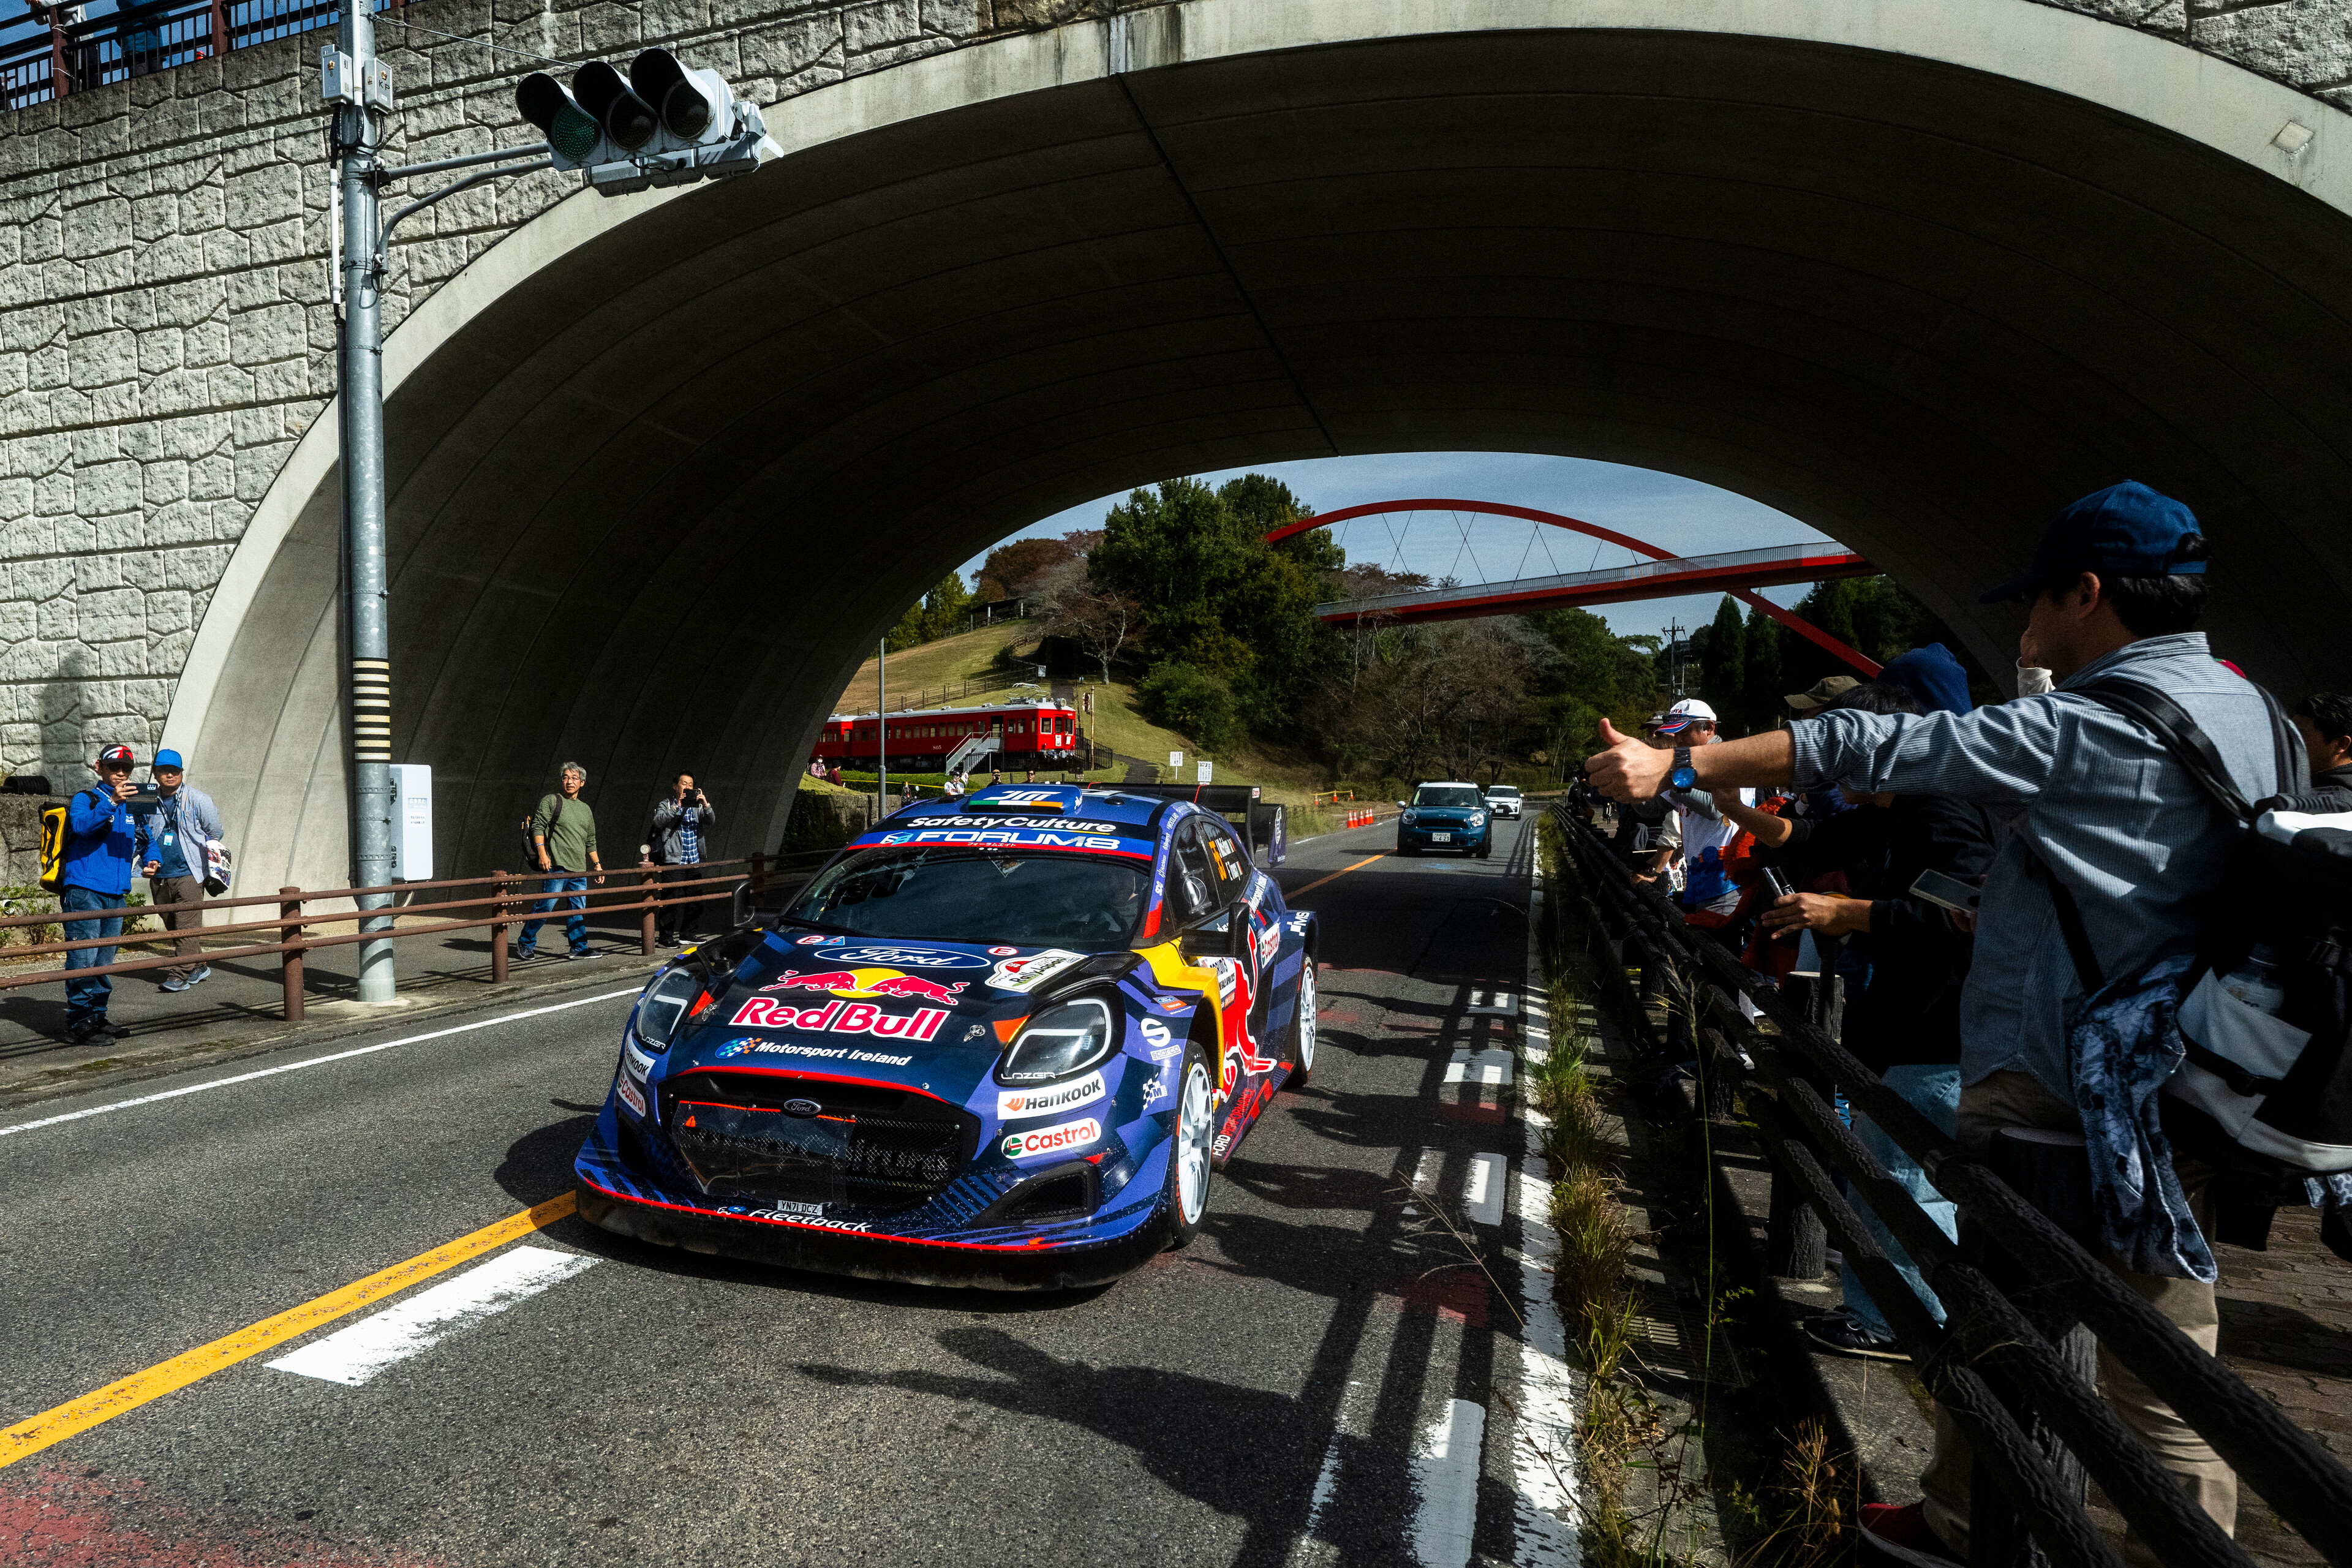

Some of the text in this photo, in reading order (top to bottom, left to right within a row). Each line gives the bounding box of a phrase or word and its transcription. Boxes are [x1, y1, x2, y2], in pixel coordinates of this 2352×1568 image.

[907, 816, 1117, 833] SafetyCulture
[914, 831, 1120, 850] FORUM8
[1264, 929, 1280, 959] Castrol
[839, 948, 962, 965] Ford
[731, 997, 948, 1040] Red Bull
[755, 1041, 913, 1066] Motorsport Ireland
[1152, 1046, 1179, 1059] sparco
[620, 1079, 644, 1114] Castrol
[791, 1101, 813, 1112] Ford
[1025, 1121, 1096, 1152] Castrol
[1213, 1134, 1231, 1156] FORD
[782, 1200, 818, 1214] YN71 DCZ
